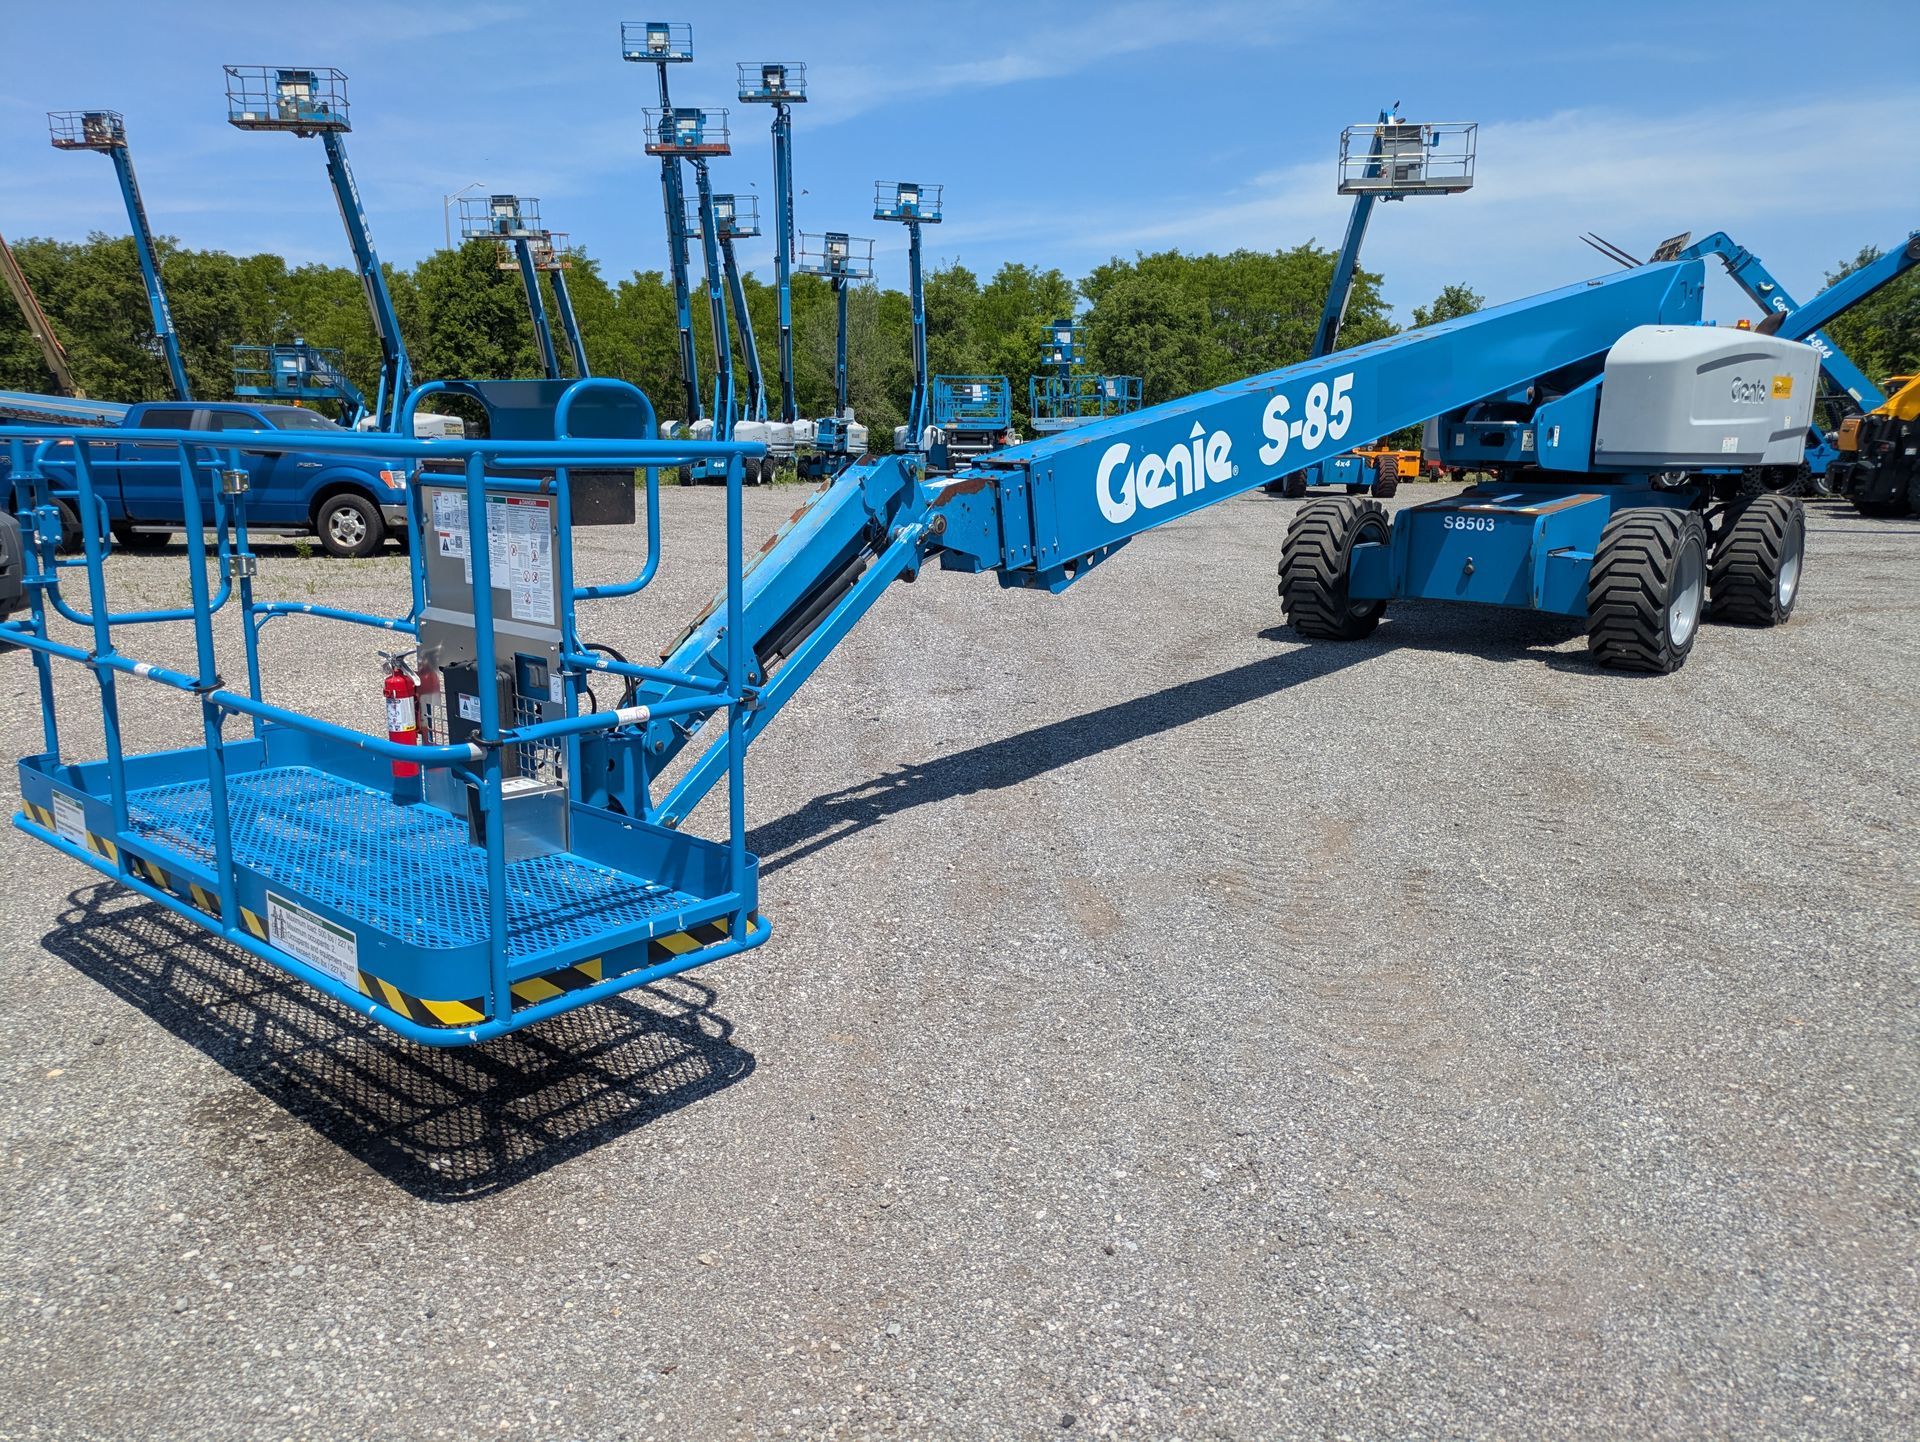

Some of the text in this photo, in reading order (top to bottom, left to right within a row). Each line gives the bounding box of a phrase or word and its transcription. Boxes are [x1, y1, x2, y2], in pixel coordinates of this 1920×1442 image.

[1258, 372, 1354, 466] S-85
[1731, 377, 1765, 404] Genie
[1096, 420, 1232, 524] Genie
[1443, 515, 1495, 532] S8503
